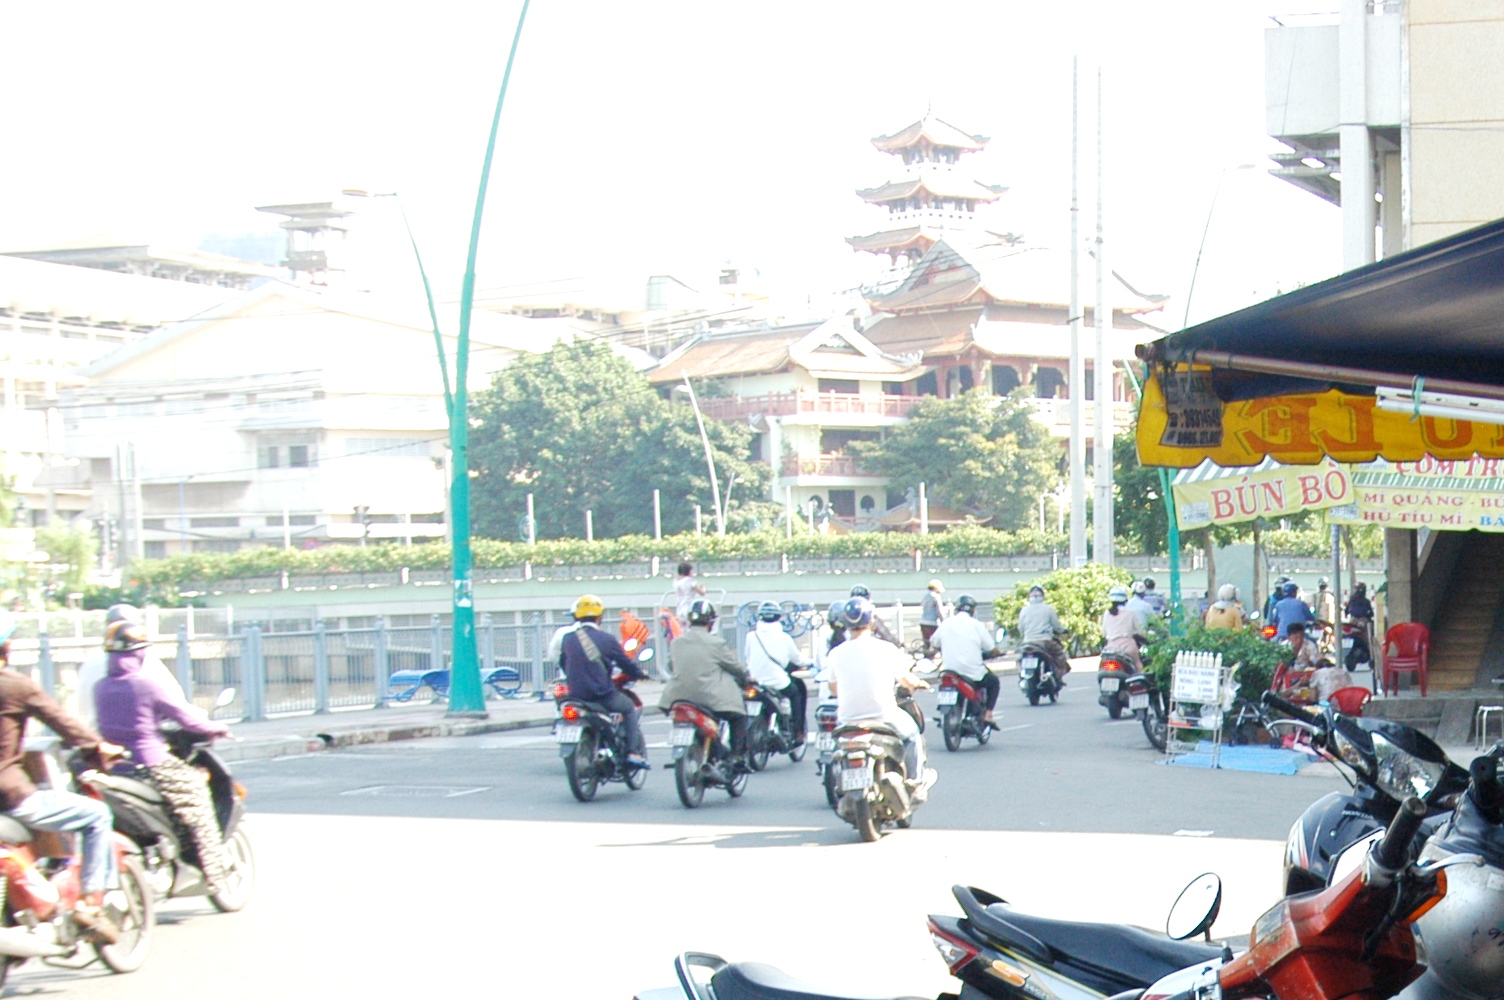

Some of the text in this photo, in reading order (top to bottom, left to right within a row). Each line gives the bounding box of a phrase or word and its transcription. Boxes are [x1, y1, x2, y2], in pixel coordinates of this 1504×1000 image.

[1211, 475, 1287, 520] BÚN
[1298, 460, 1348, 506] BÒ
[1391, 489, 1465, 508] QUẢNG
